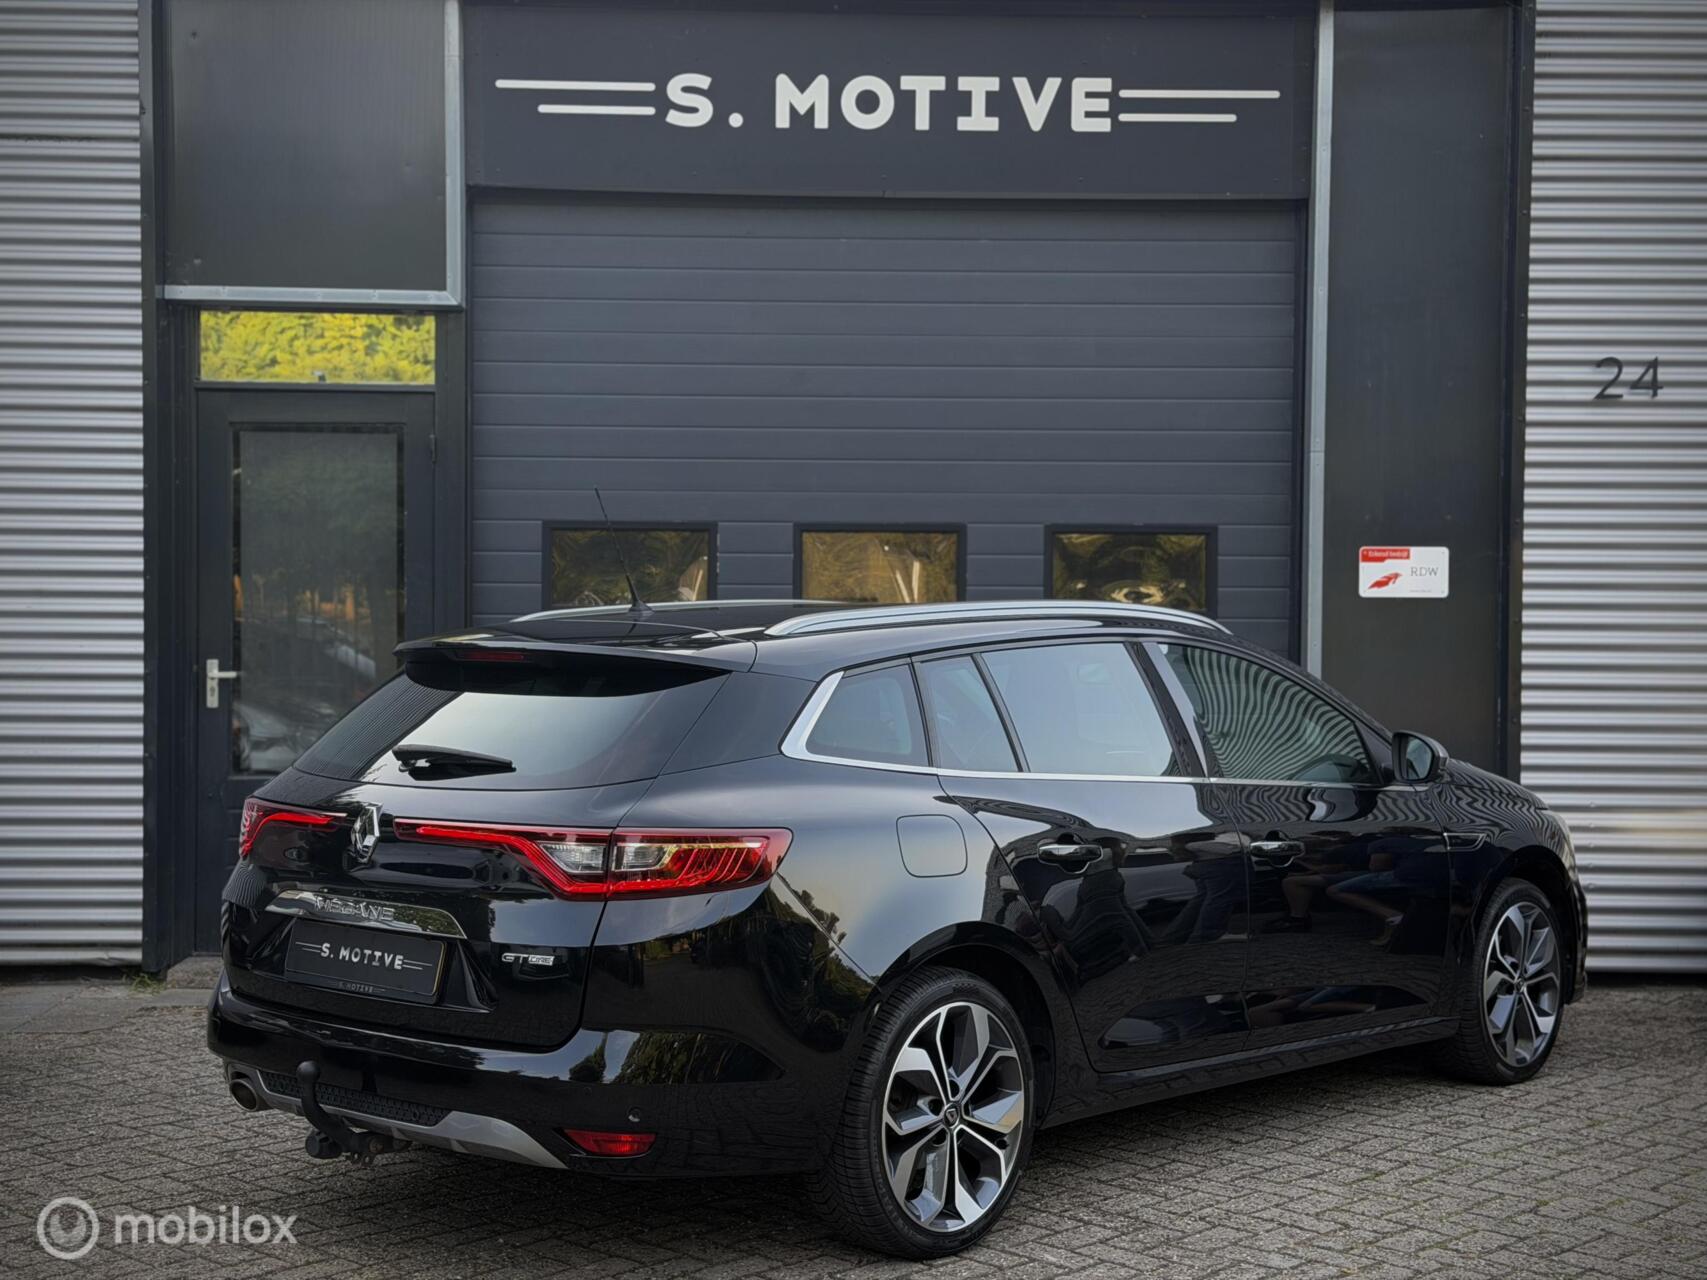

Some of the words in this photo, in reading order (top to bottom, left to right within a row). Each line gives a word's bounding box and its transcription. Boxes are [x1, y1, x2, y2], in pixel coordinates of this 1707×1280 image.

[665, 72, 744, 129] S.
[775, 73, 1114, 134] MOTIVE
[1593, 356, 1664, 400] 24
[1410, 566, 1439, 577] RDW
[320, 942, 335, 959] S.
[338, 945, 404, 970] MOTIVE
